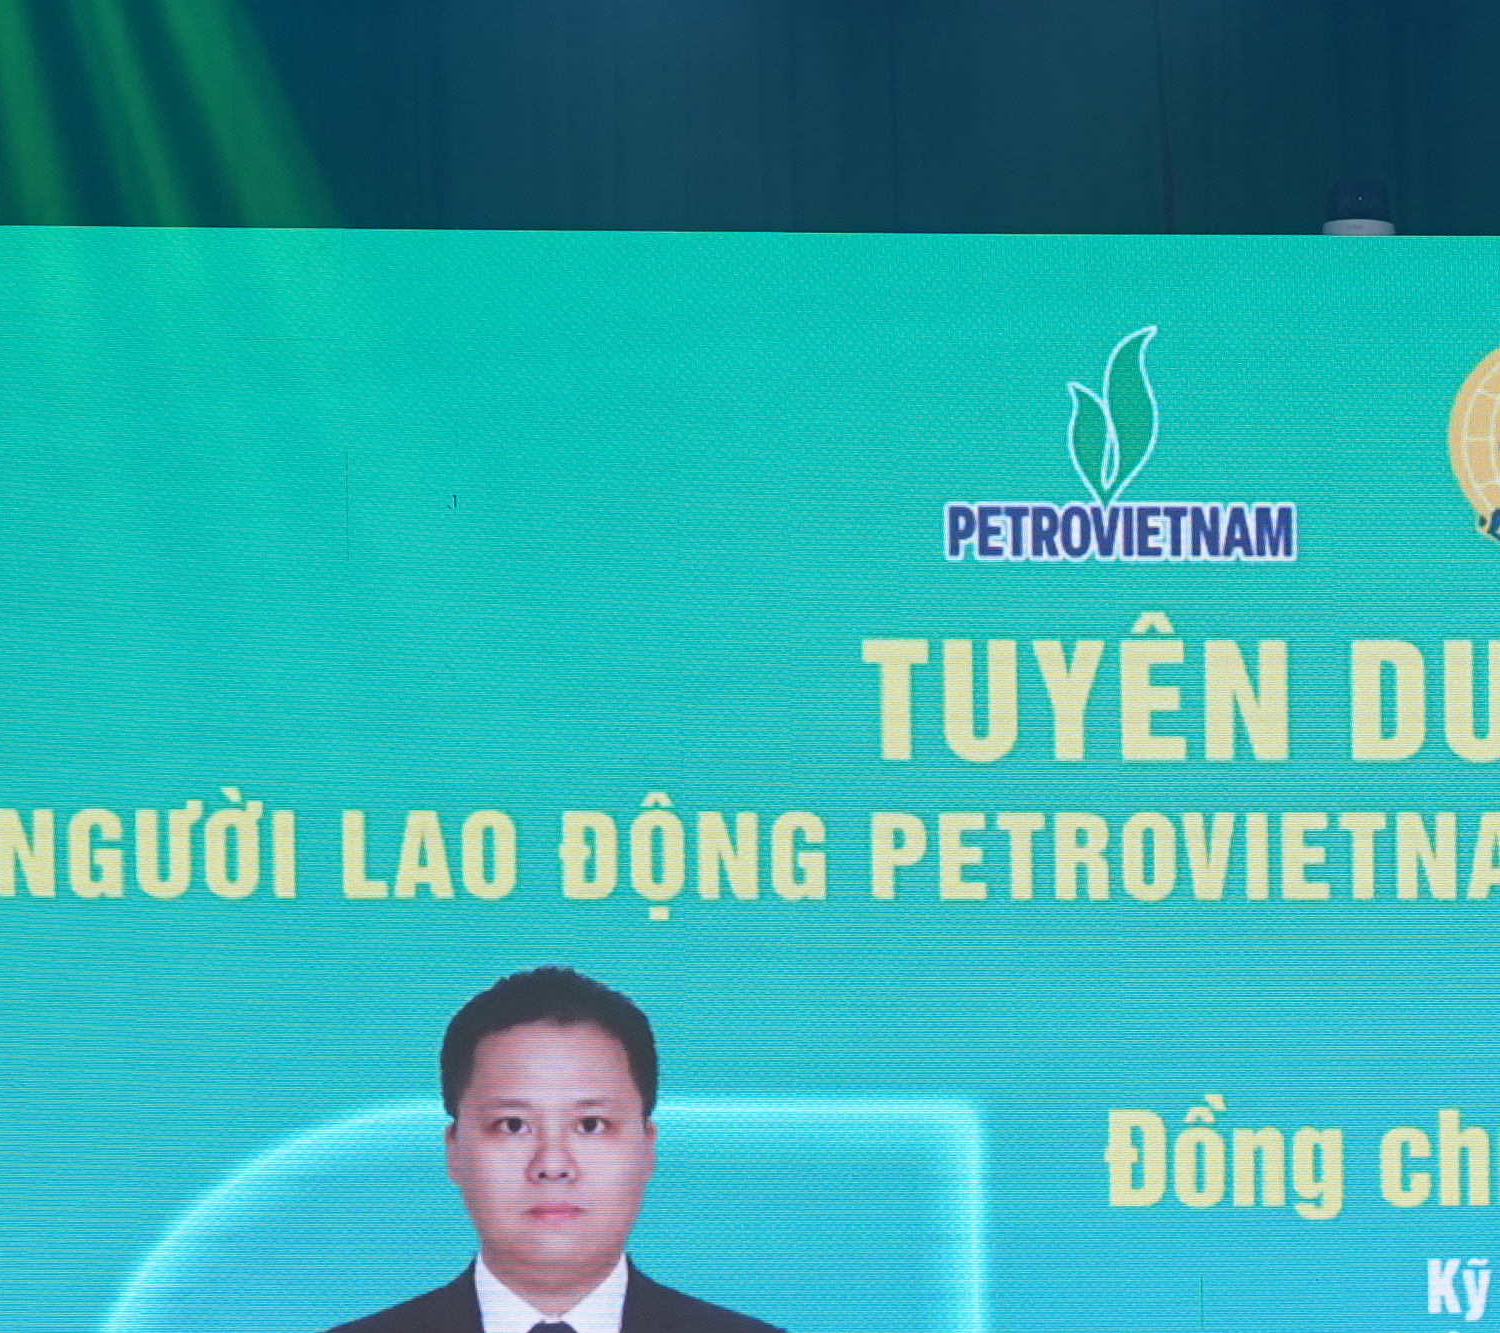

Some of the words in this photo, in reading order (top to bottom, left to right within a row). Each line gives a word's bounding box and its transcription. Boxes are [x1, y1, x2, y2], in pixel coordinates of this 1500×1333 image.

[946, 503, 1296, 560] PETROVIETNAM
[861, 611, 1290, 762] TUYÊN
[342, 809, 518, 900] LAO
[559, 792, 827, 921] ĐỘNG
[1104, 1094, 1344, 1220] Đồng
[1426, 1257, 1492, 1321] Kỹ
